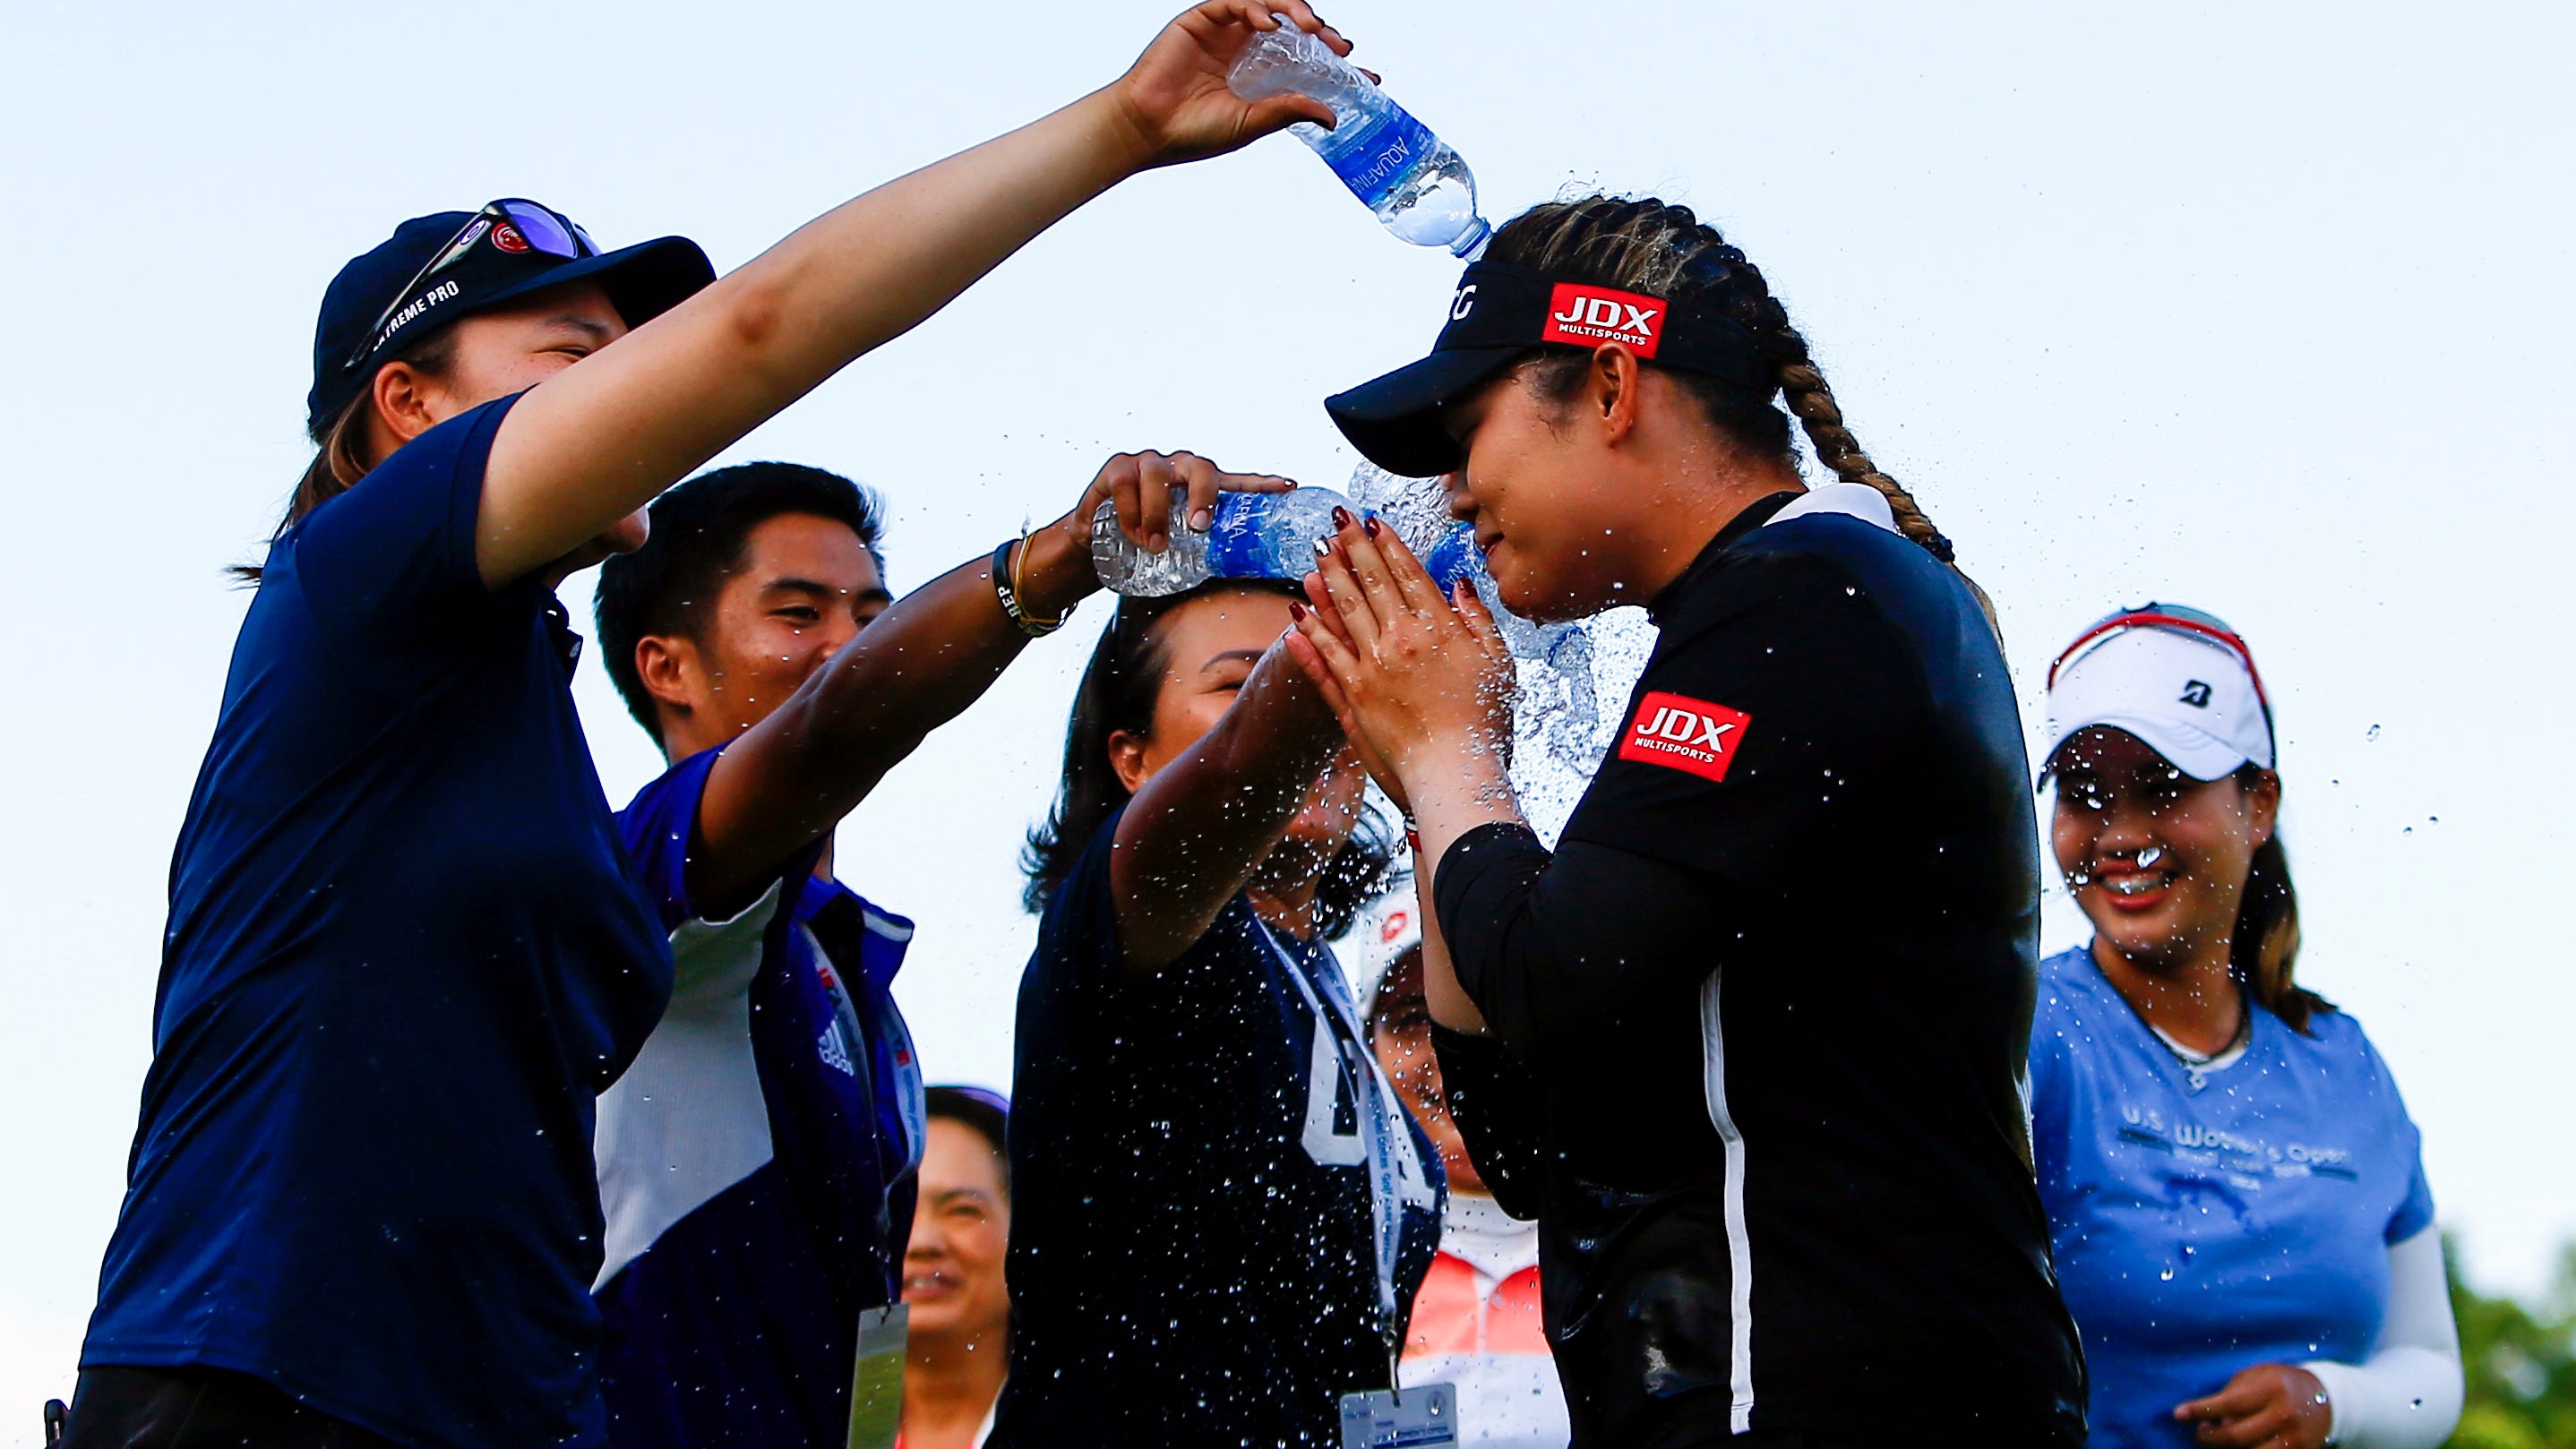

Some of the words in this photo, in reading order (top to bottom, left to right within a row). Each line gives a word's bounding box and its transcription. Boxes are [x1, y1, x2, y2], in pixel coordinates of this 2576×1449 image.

[1348, 135, 1411, 195] AQUAFINA
[373, 298, 427, 352] TREME
[426, 280, 459, 306] PRO
[1554, 296, 1658, 336] JDX
[1558, 323, 1647, 346] MULTISPORTS
[1634, 737, 1715, 764] MULTISPORTS
[1636, 707, 1737, 754] JDX
